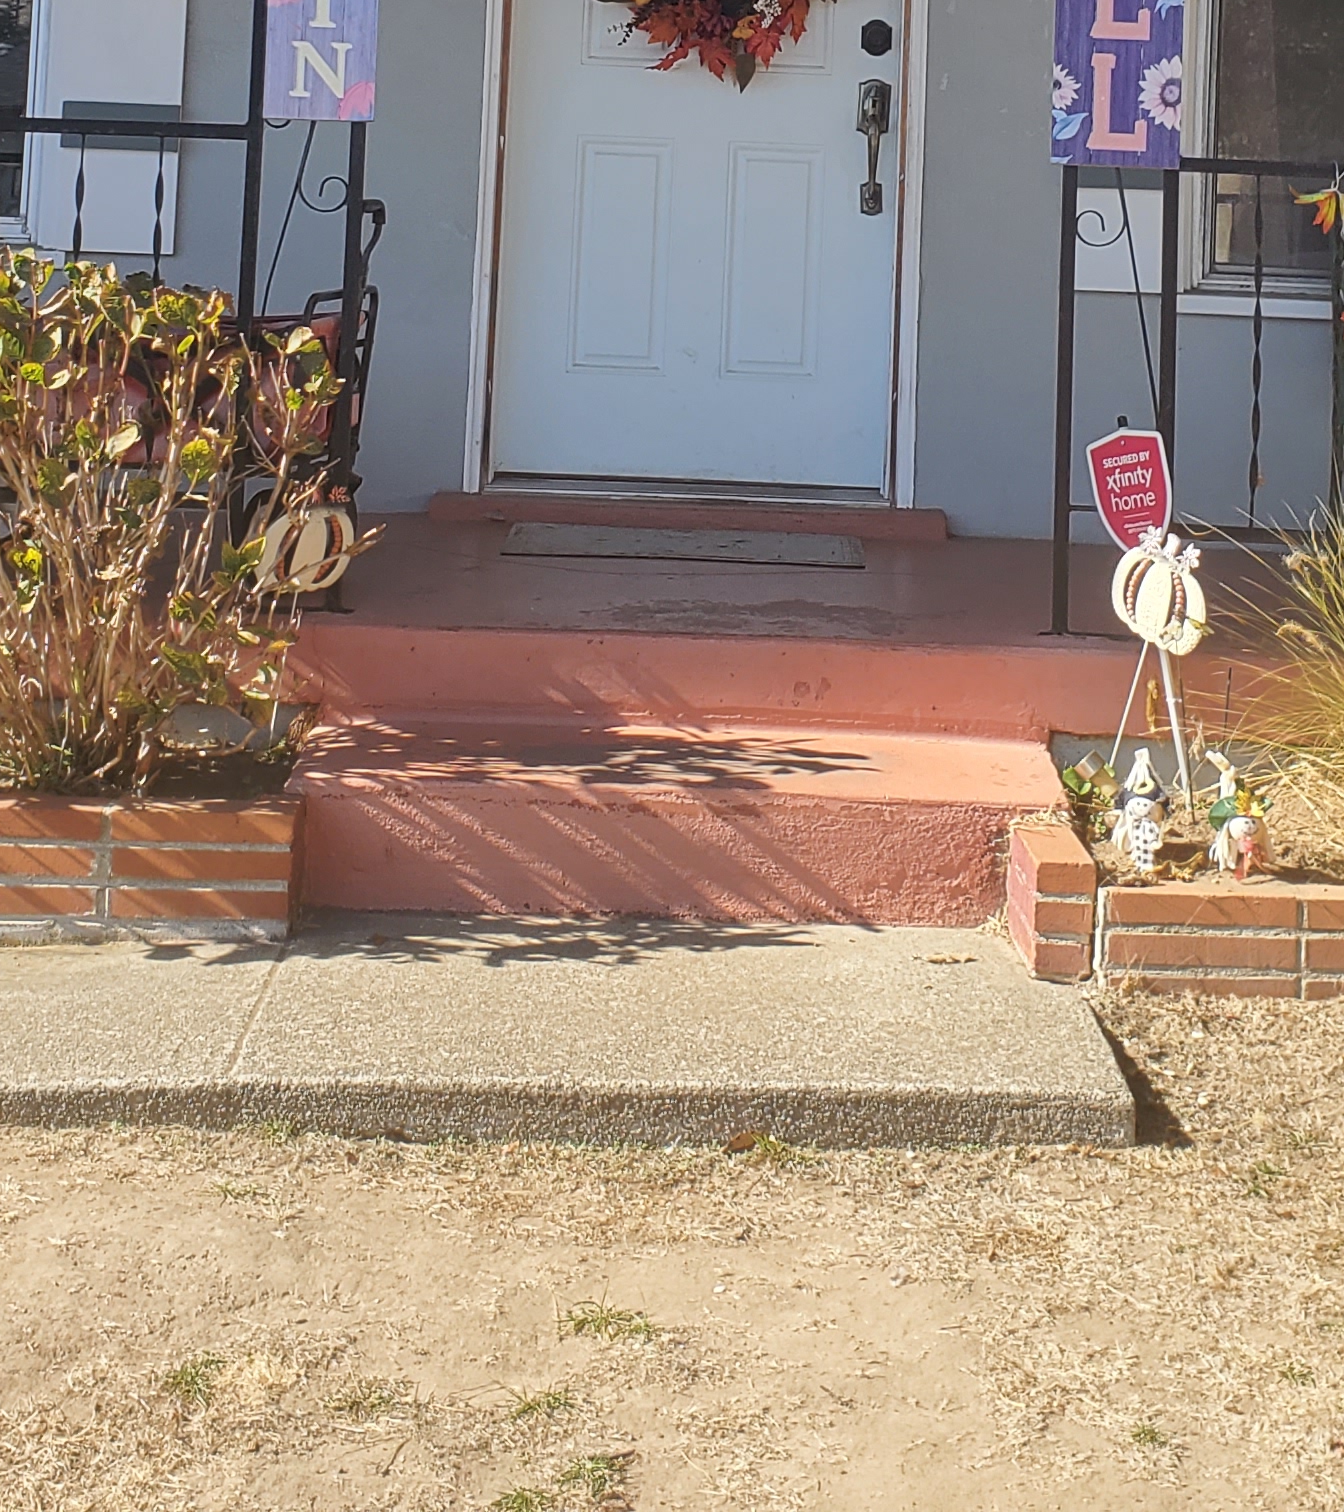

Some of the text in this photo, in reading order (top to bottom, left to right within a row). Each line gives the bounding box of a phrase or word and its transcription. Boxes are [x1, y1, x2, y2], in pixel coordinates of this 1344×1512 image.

[1102, 450, 1150, 469] SECURED BY
[1106, 465, 1153, 493] xfinity
[1110, 491, 1156, 512] home
